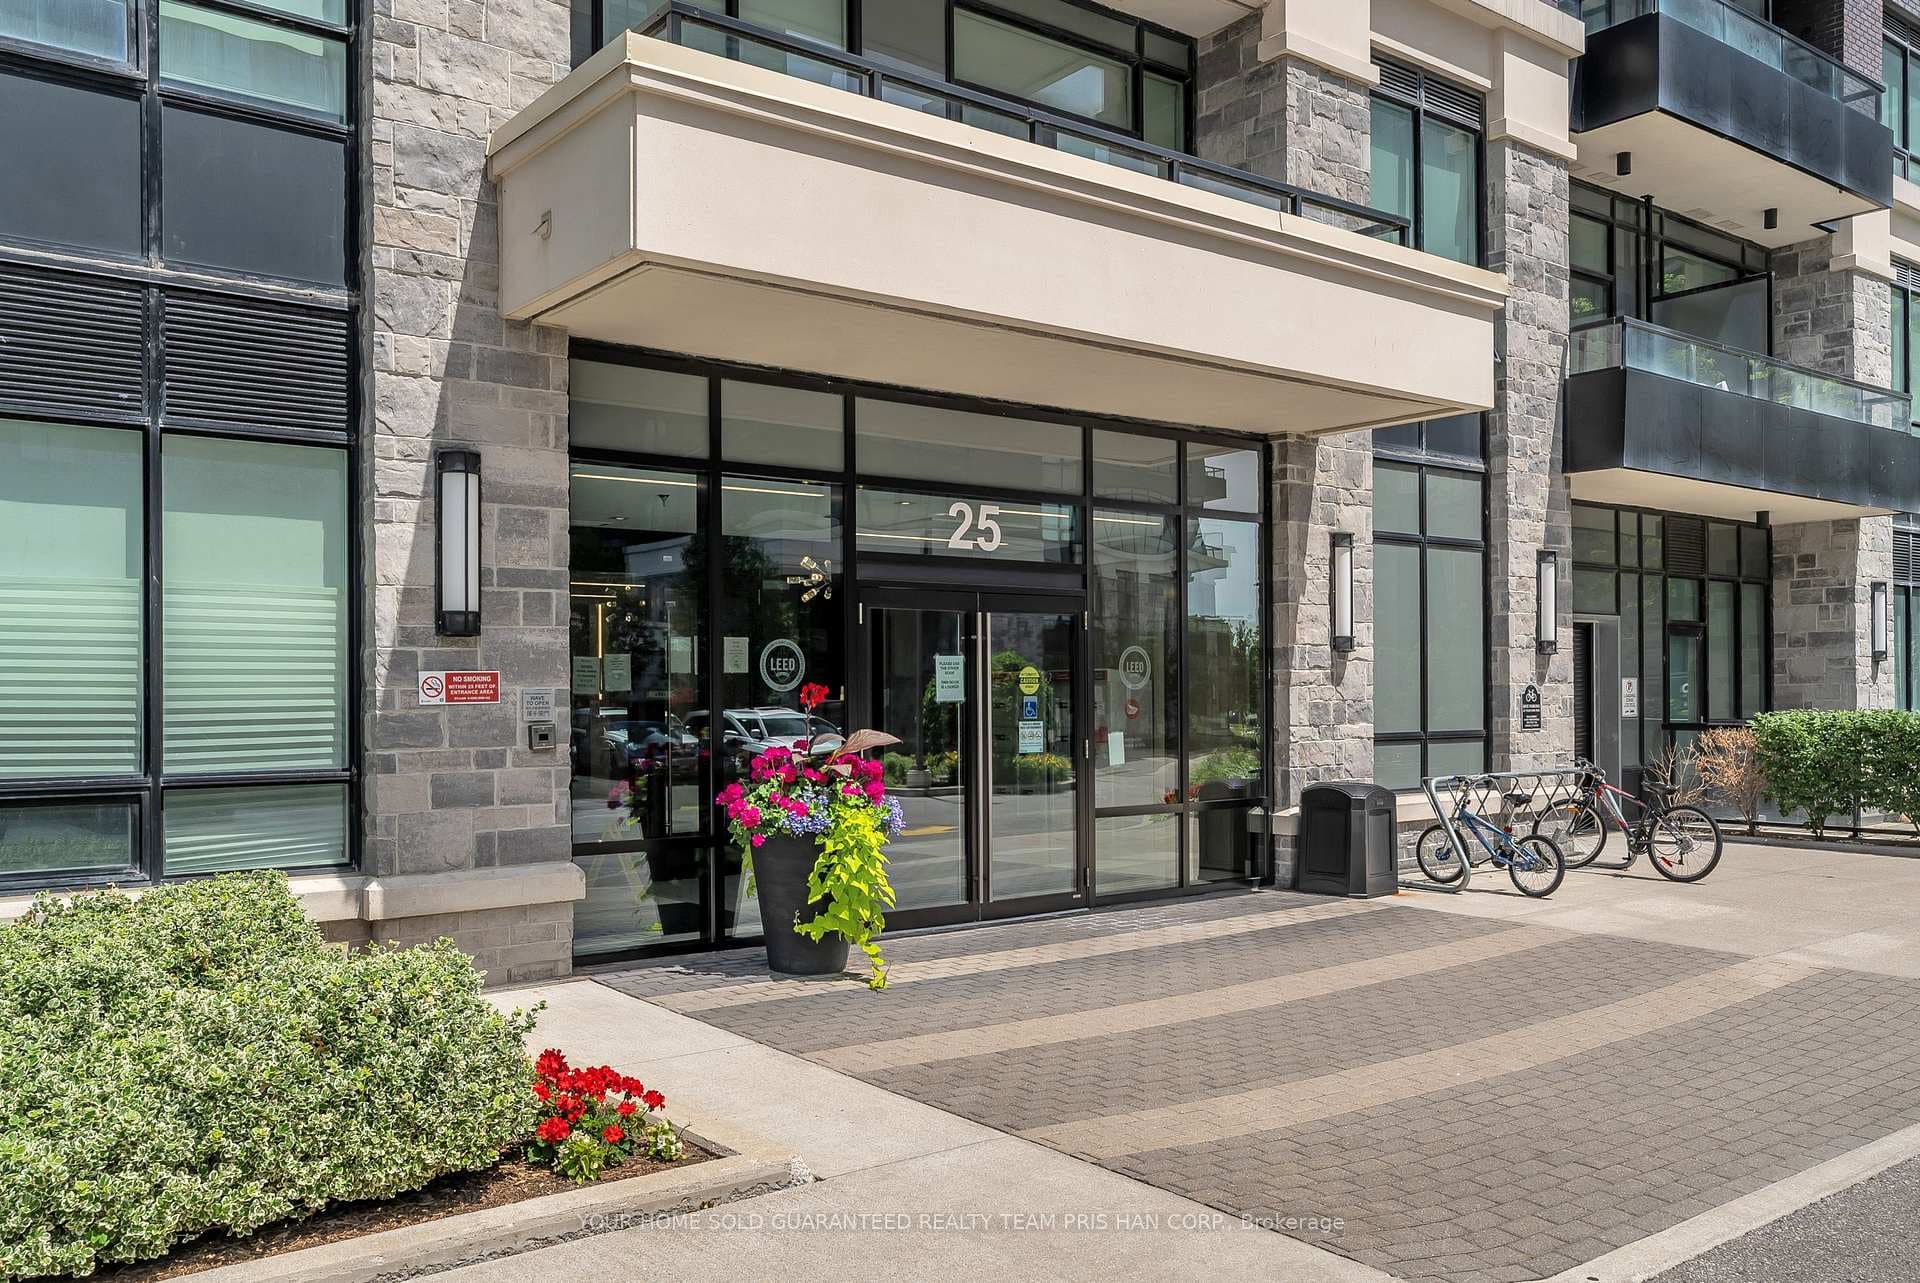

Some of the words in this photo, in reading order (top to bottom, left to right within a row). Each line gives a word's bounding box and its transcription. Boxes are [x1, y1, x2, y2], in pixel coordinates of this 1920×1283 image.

[948, 502, 1001, 552] 25
[770, 657, 796, 671] LEED
[1126, 661, 1144, 673] LEED
